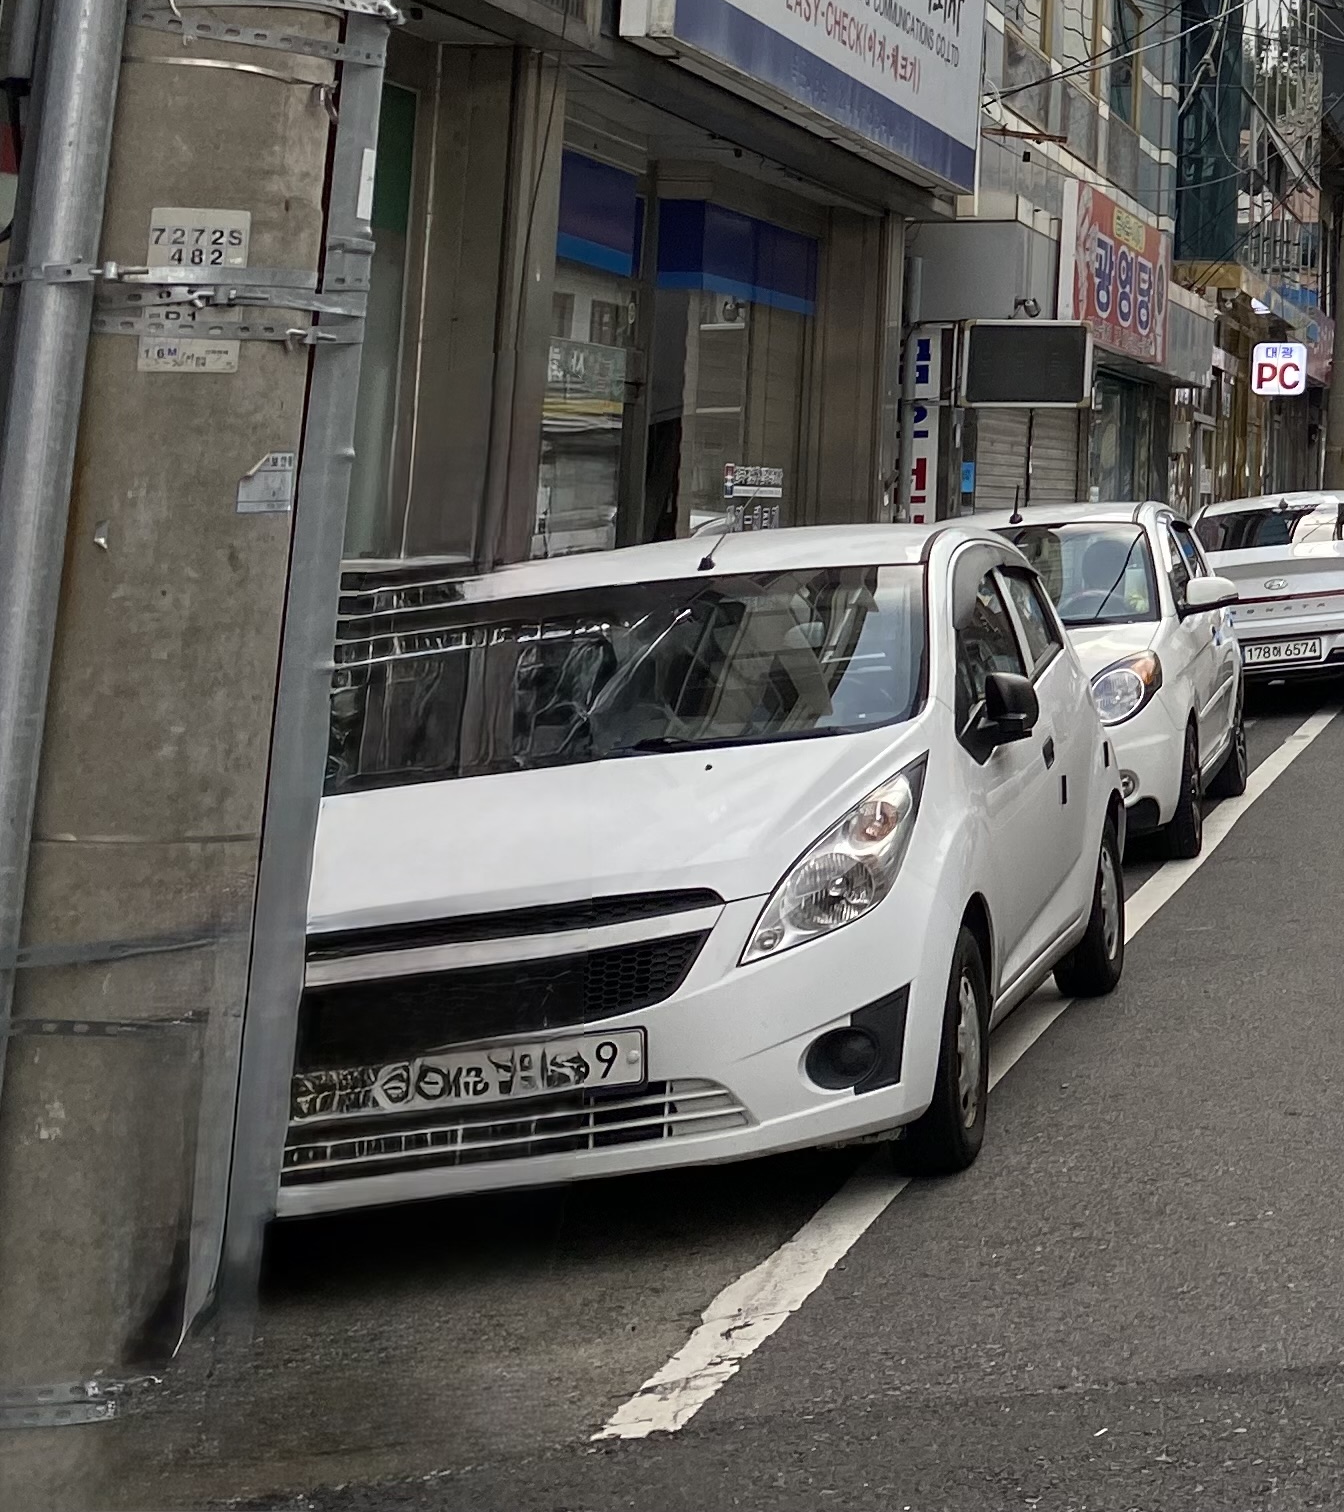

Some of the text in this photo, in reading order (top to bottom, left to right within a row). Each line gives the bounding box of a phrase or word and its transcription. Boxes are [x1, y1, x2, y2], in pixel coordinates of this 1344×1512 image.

[170, 248, 223, 265] 482
[1265, 346, 1294, 359] 대광
[1256, 362, 1300, 389] PC
[1284, 641, 1318, 657] 6574
